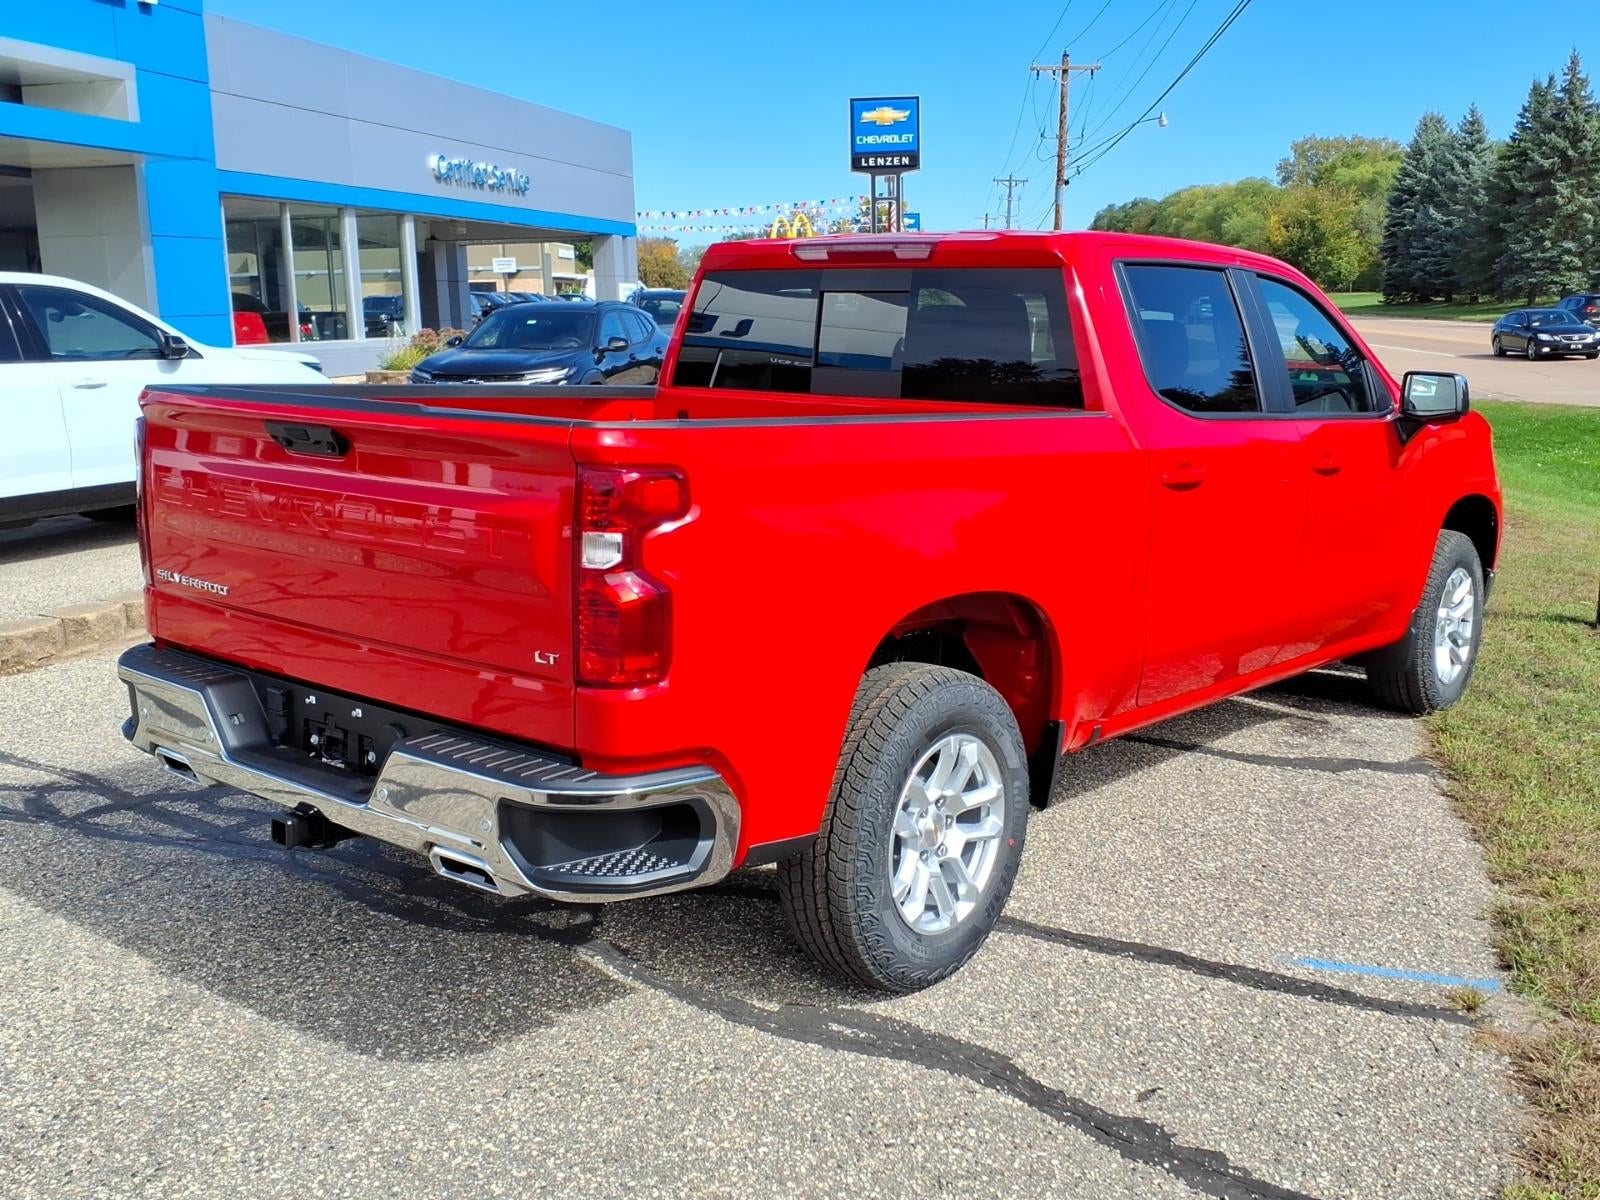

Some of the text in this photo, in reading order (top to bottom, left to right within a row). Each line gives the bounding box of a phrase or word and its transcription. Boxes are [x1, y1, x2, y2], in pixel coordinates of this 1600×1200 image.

[856, 134, 914, 145] CHEVROLET
[861, 156, 909, 167] LENZEN
[434, 153, 530, 195] Certified Service
[156, 568, 229, 596] SILVERADO
[534, 650, 560, 665] LT
